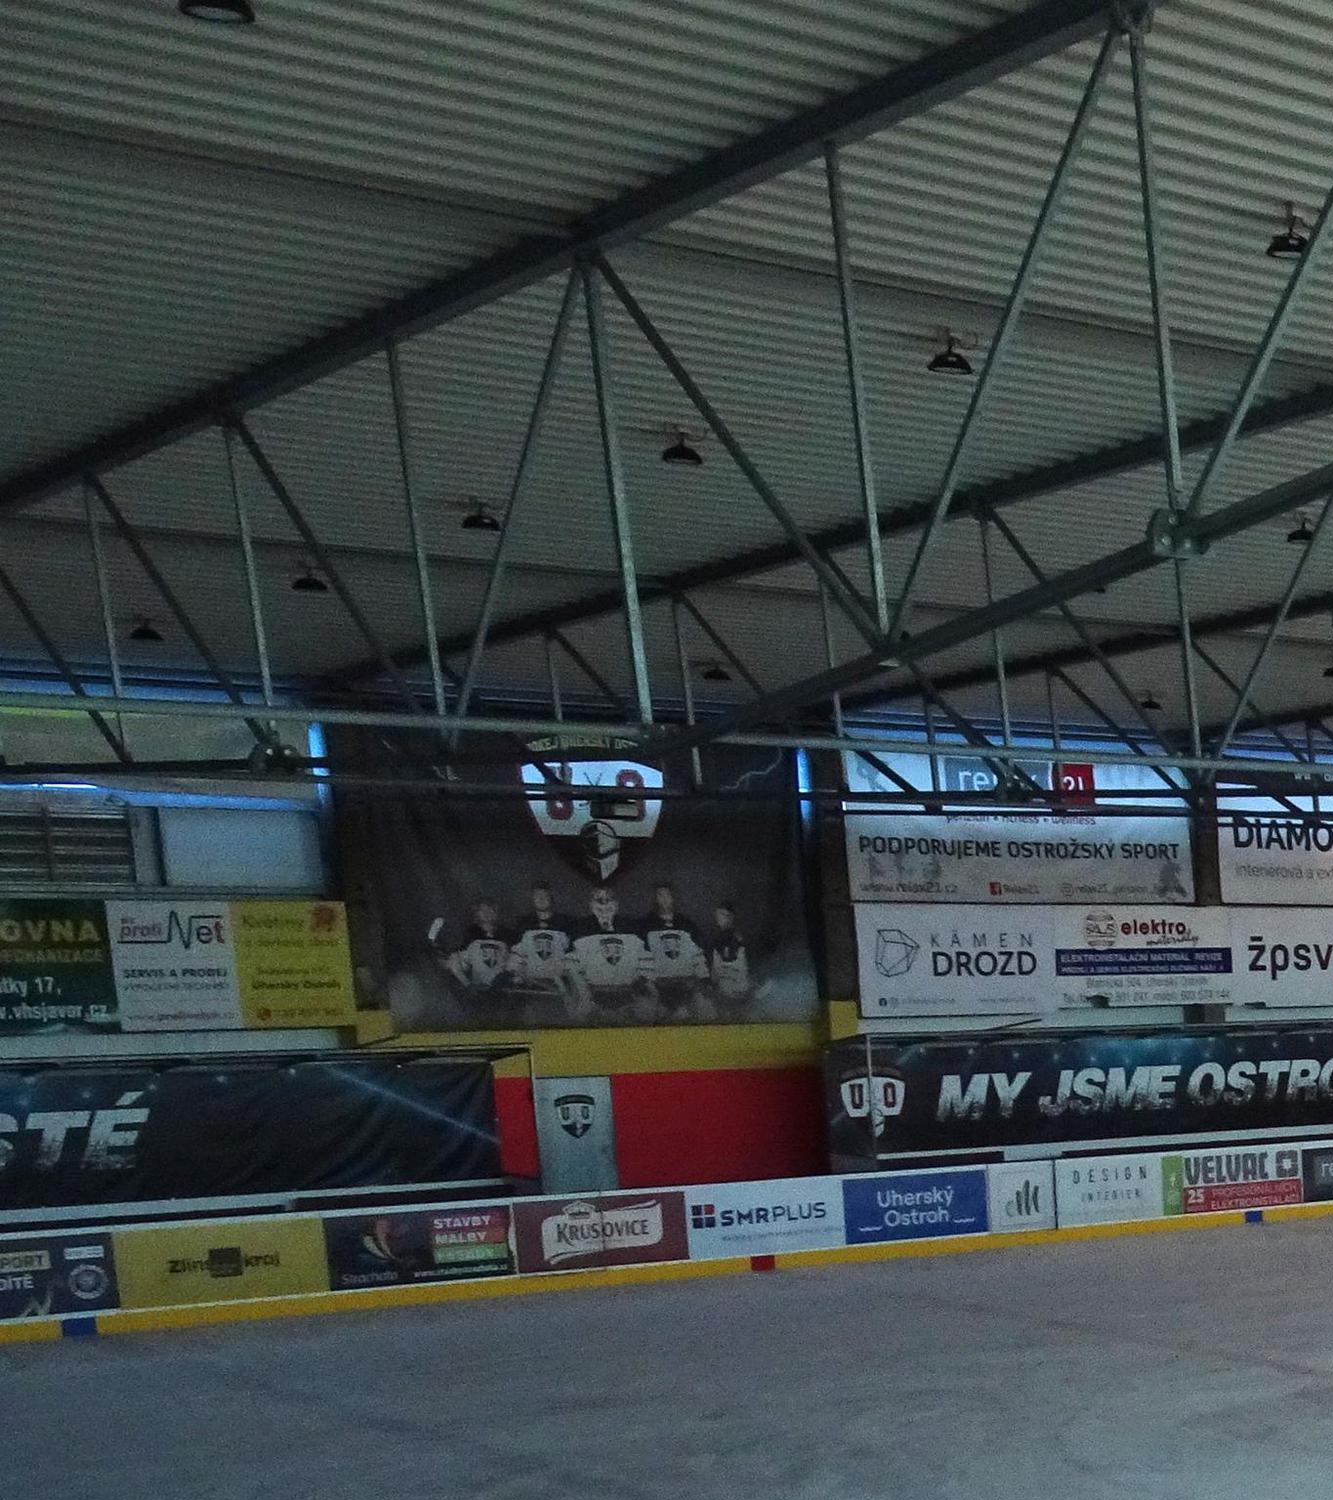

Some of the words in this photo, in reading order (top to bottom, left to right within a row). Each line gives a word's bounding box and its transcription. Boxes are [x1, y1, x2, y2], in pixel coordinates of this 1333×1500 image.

[859, 835, 1001, 859] PODPORUJEME
[1008, 838, 1115, 860] OSTROŽSKÝ
[1120, 843, 1179, 860] SPORT
[930, 931, 1034, 948] KÁMEN
[1120, 919, 1187, 936] elektro
[932, 951, 1038, 977] DROZD
[937, 1071, 1032, 1122] MY
[1039, 1063, 1181, 1117] JSME
[876, 1184, 955, 1208] Uherský
[1187, 1189, 1205, 1204] 25
[719, 1201, 827, 1228] SMRPLUS
[884, 1208, 950, 1227] Ostroh
